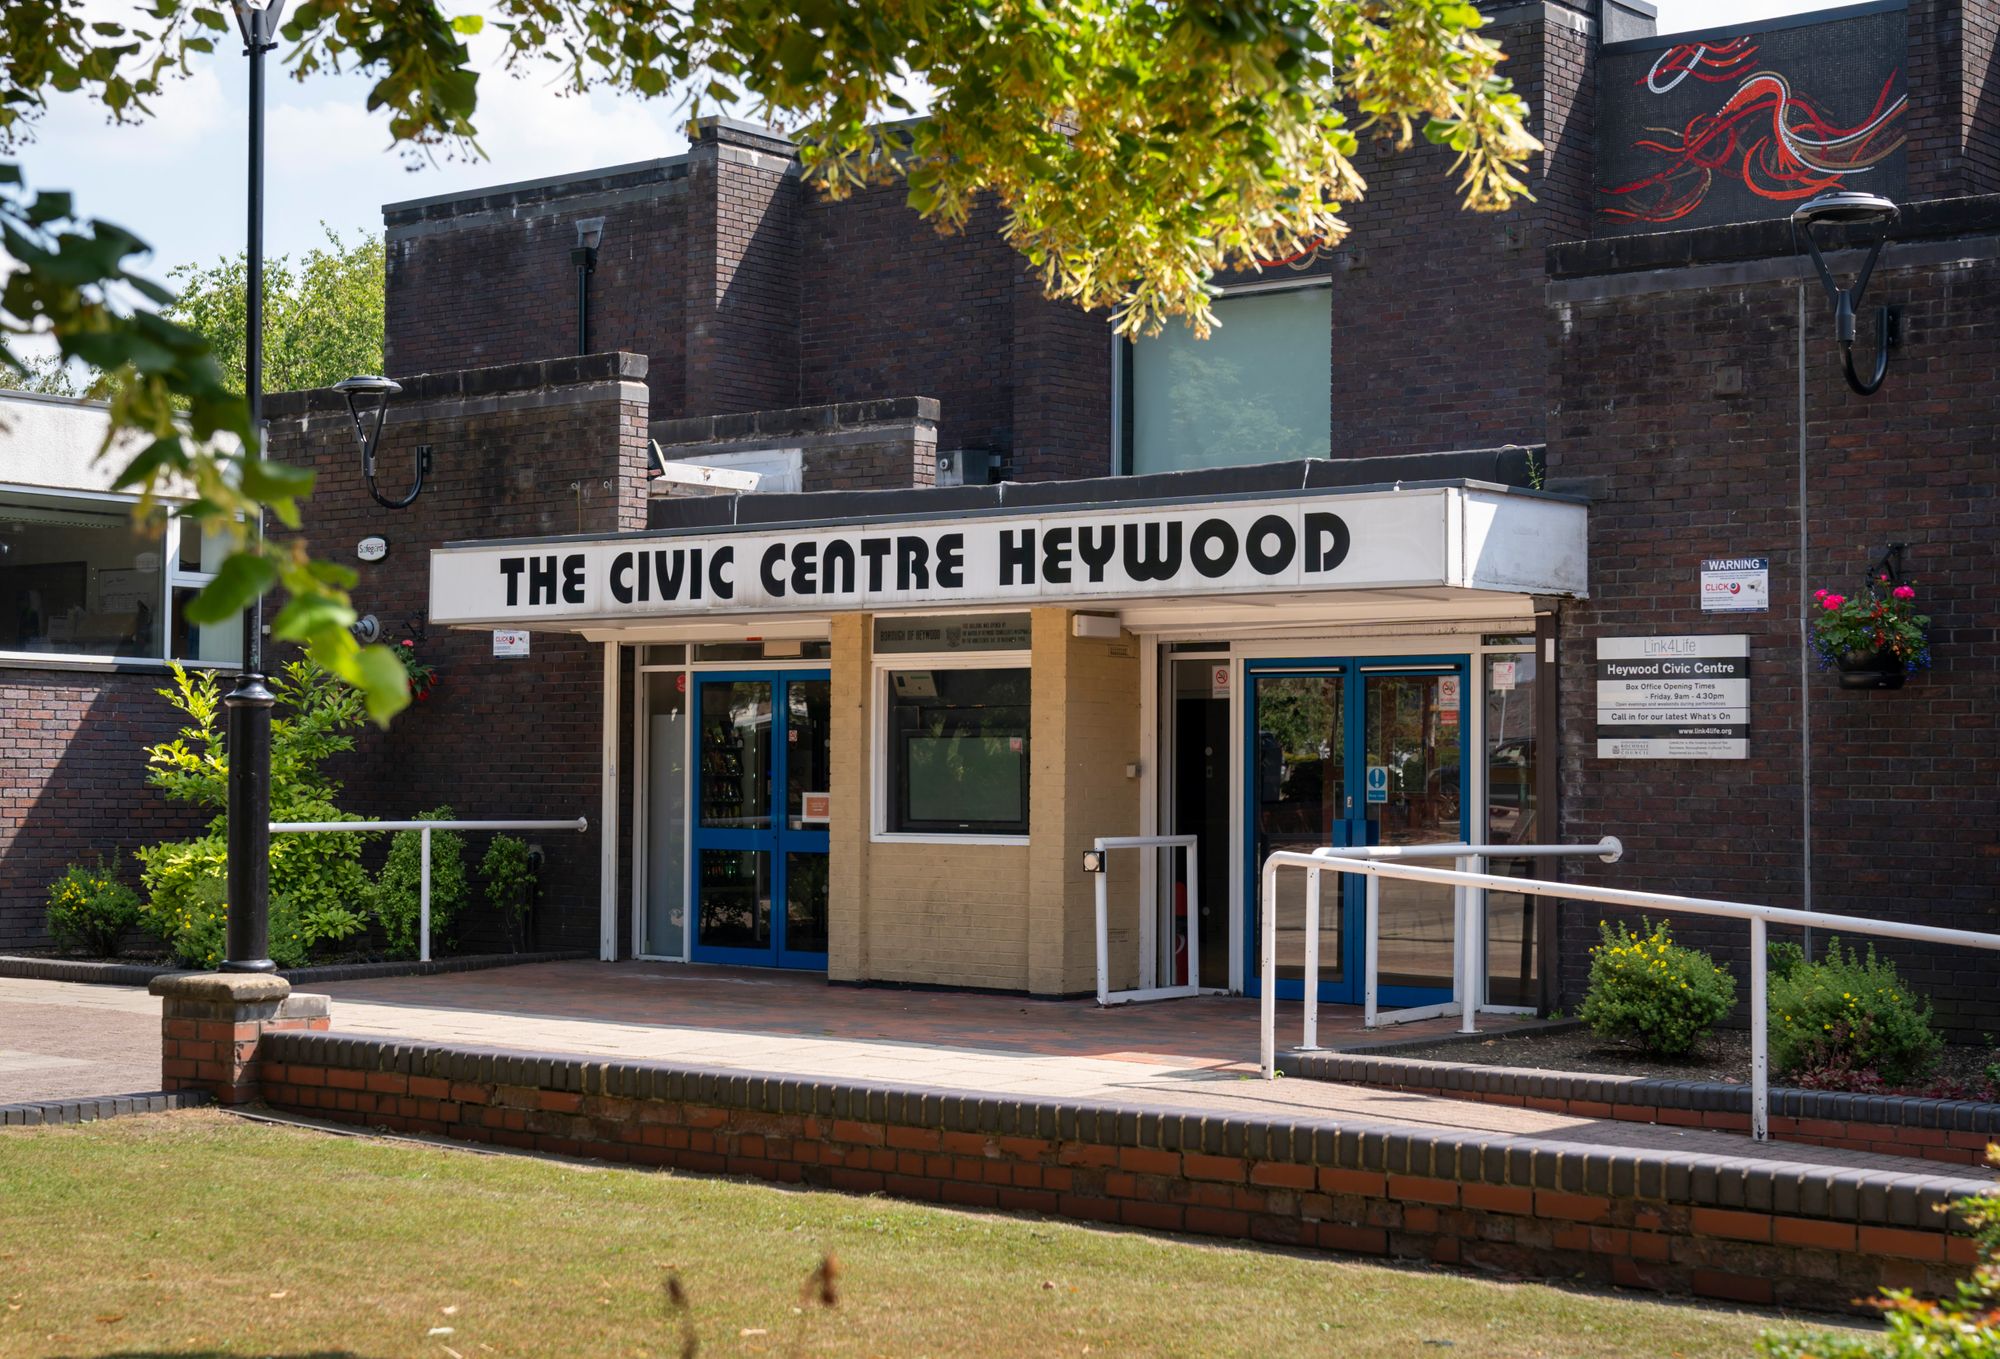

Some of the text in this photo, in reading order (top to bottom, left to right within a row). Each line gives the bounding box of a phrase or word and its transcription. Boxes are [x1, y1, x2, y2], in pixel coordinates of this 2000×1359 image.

[500, 512, 1351, 606] THE CIVIC CENTRE HEYWOOD
[1708, 559, 1760, 570] WARNING
[1644, 638, 1697, 654] Link4Life
[1607, 661, 1735, 677] Heywood Civic Centre
[1663, 683, 1693, 691] Opening
[1694, 682, 1716, 690] Times
[1674, 692, 1690, 700] 9am
[1696, 692, 1725, 701] 4.30pm
[1611, 713, 1627, 721] Call
[1628, 713, 1636, 721] in
[1638, 713, 1648, 721] for
[1665, 713, 1688, 721] latest
[1689, 712, 1717, 720] What's
[1719, 712, 1731, 720] On
[1678, 727, 1732, 736] www.link4life.org
